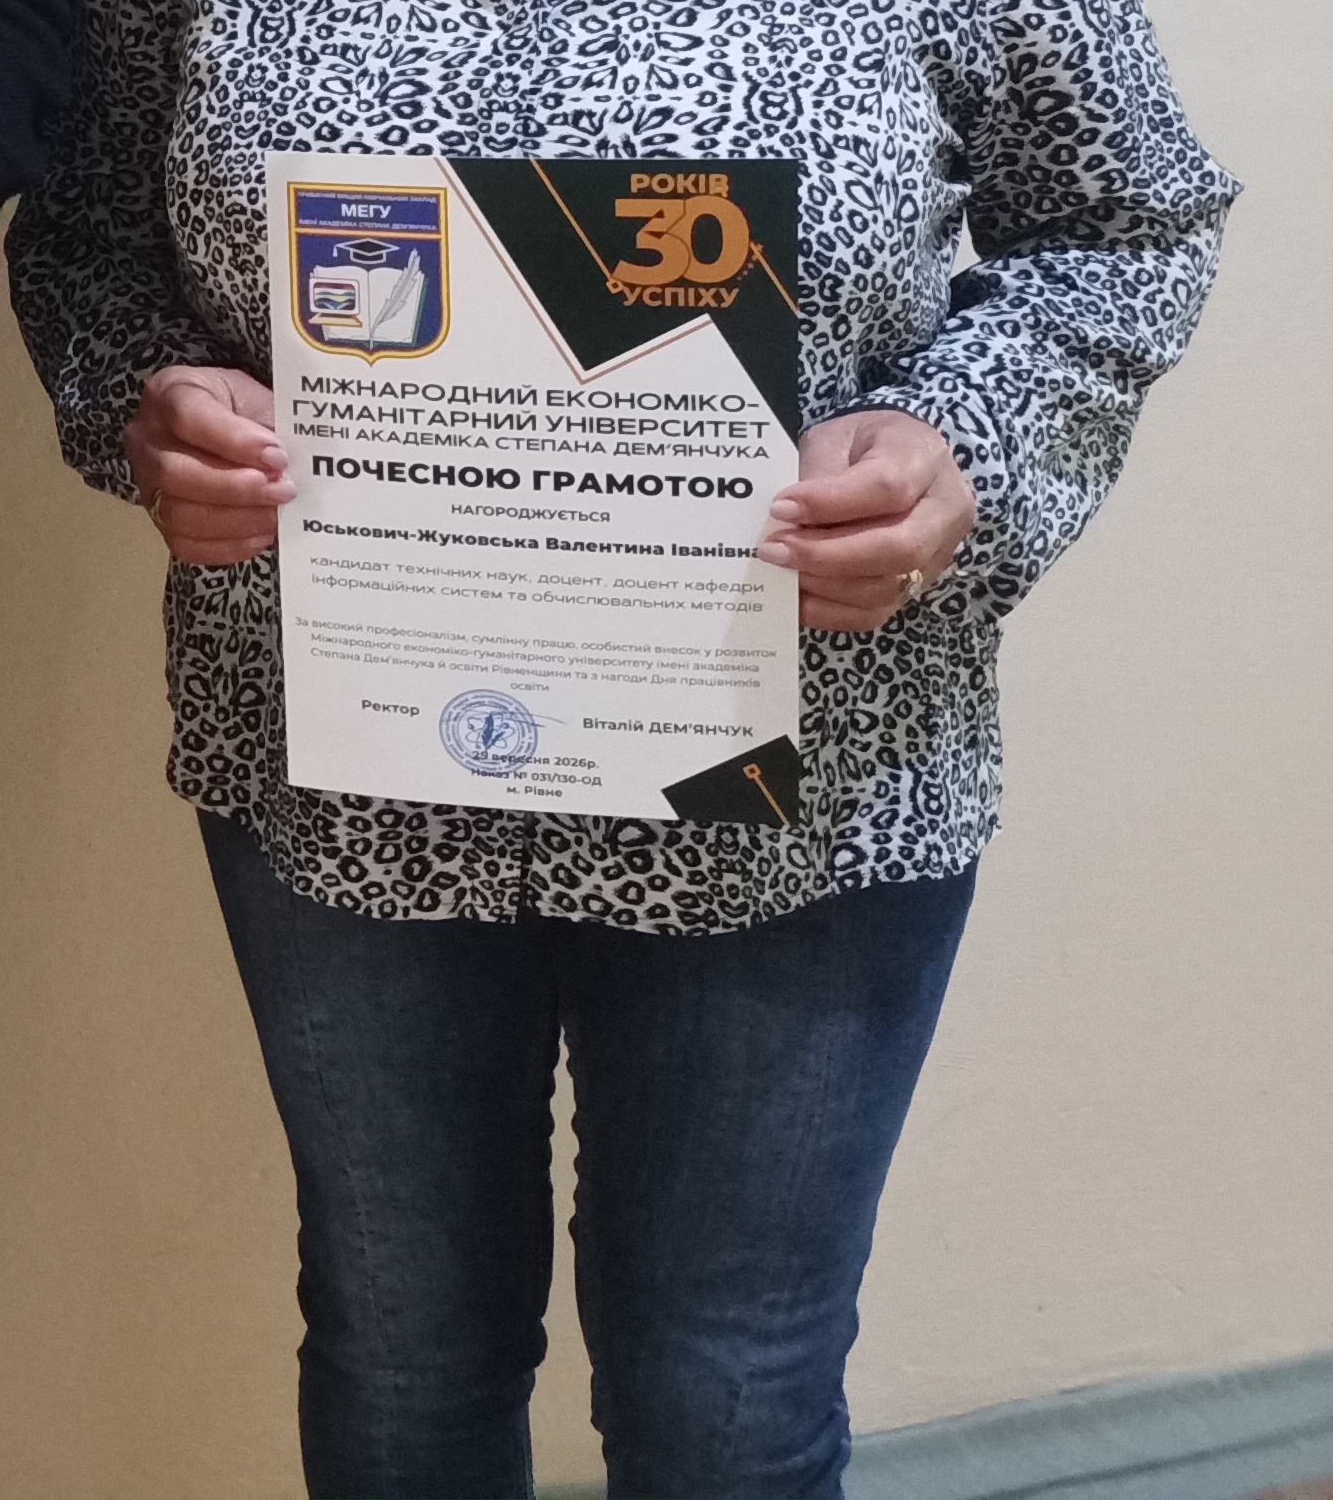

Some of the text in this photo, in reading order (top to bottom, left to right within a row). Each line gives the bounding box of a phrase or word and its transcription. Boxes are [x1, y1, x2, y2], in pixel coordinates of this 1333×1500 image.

[631, 172, 729, 198] РОКІВ
[341, 203, 392, 219] МЕГУ
[614, 195, 750, 285] 30
[621, 286, 738, 308] УСПІХУ
[300, 375, 760, 412] МІЖНАРОДНИЙ ЕКОНОМІКО-
[293, 400, 769, 439] ГУМАНІТАРНИЙ УНІВЕРСИТЕТ
[312, 455, 753, 499] ПОЧЕСНОЮ ГРАМОТОЮ
[451, 503, 610, 522] НАГОРОДЖУЄТЬСЯ
[302, 519, 664, 556] Юськович-Жуковська Валентина
[361, 699, 420, 716] Ректор
[582, 718, 643, 732] Віталій
